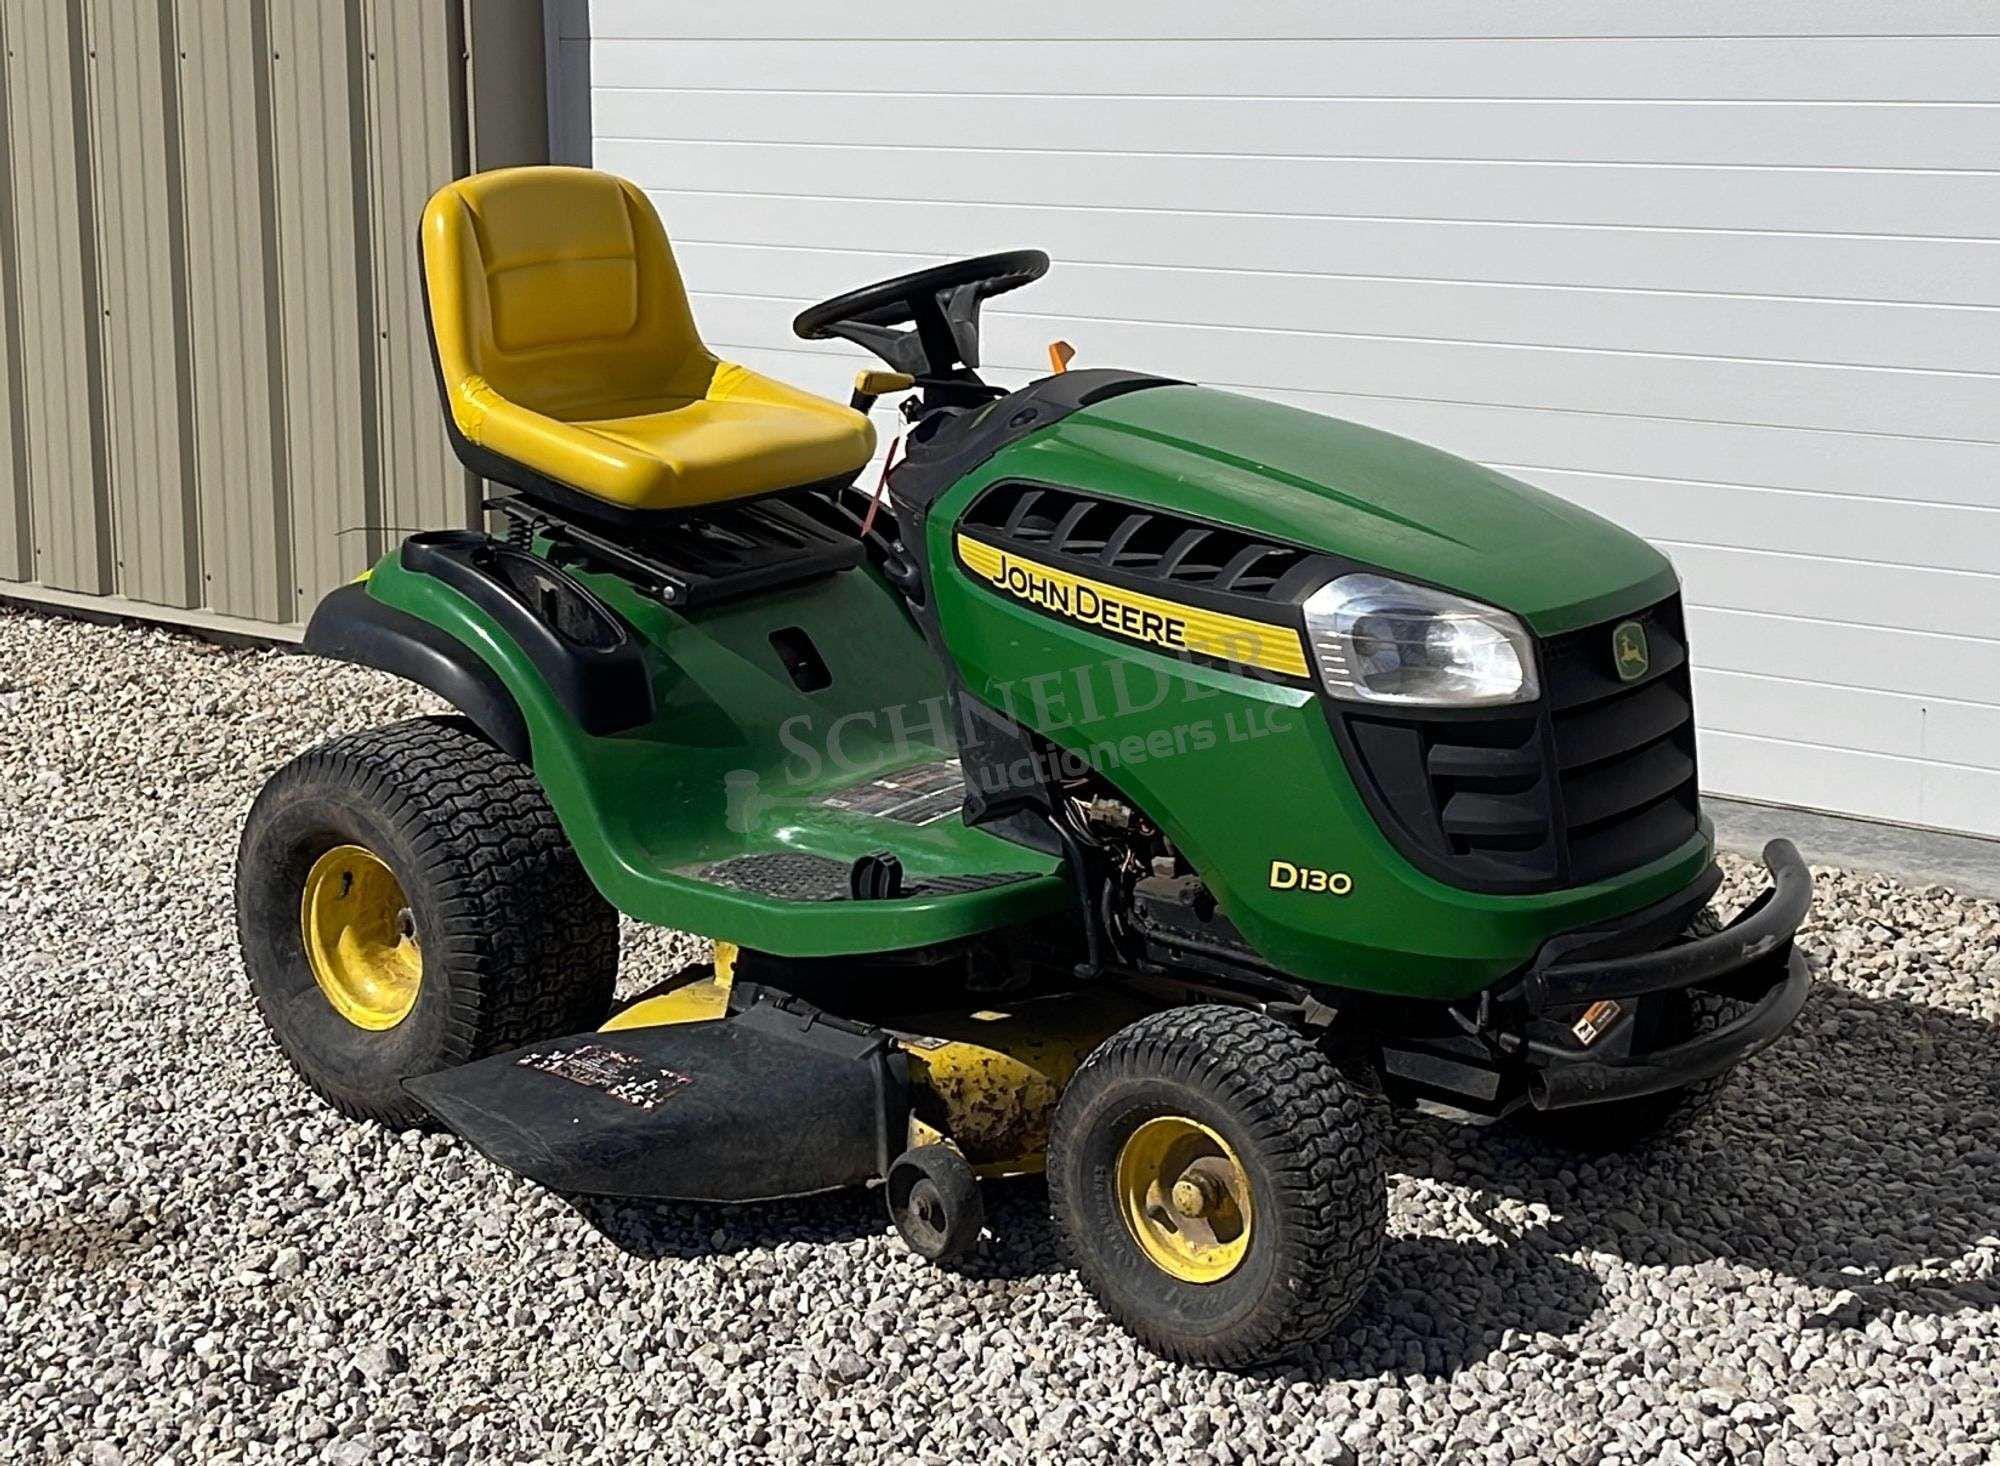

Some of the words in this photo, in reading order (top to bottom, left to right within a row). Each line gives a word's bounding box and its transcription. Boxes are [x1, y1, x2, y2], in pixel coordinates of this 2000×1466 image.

[992, 553, 1070, 612] JOHN
[1076, 584, 1186, 648] DEERE
[1269, 860, 1353, 895] D130
